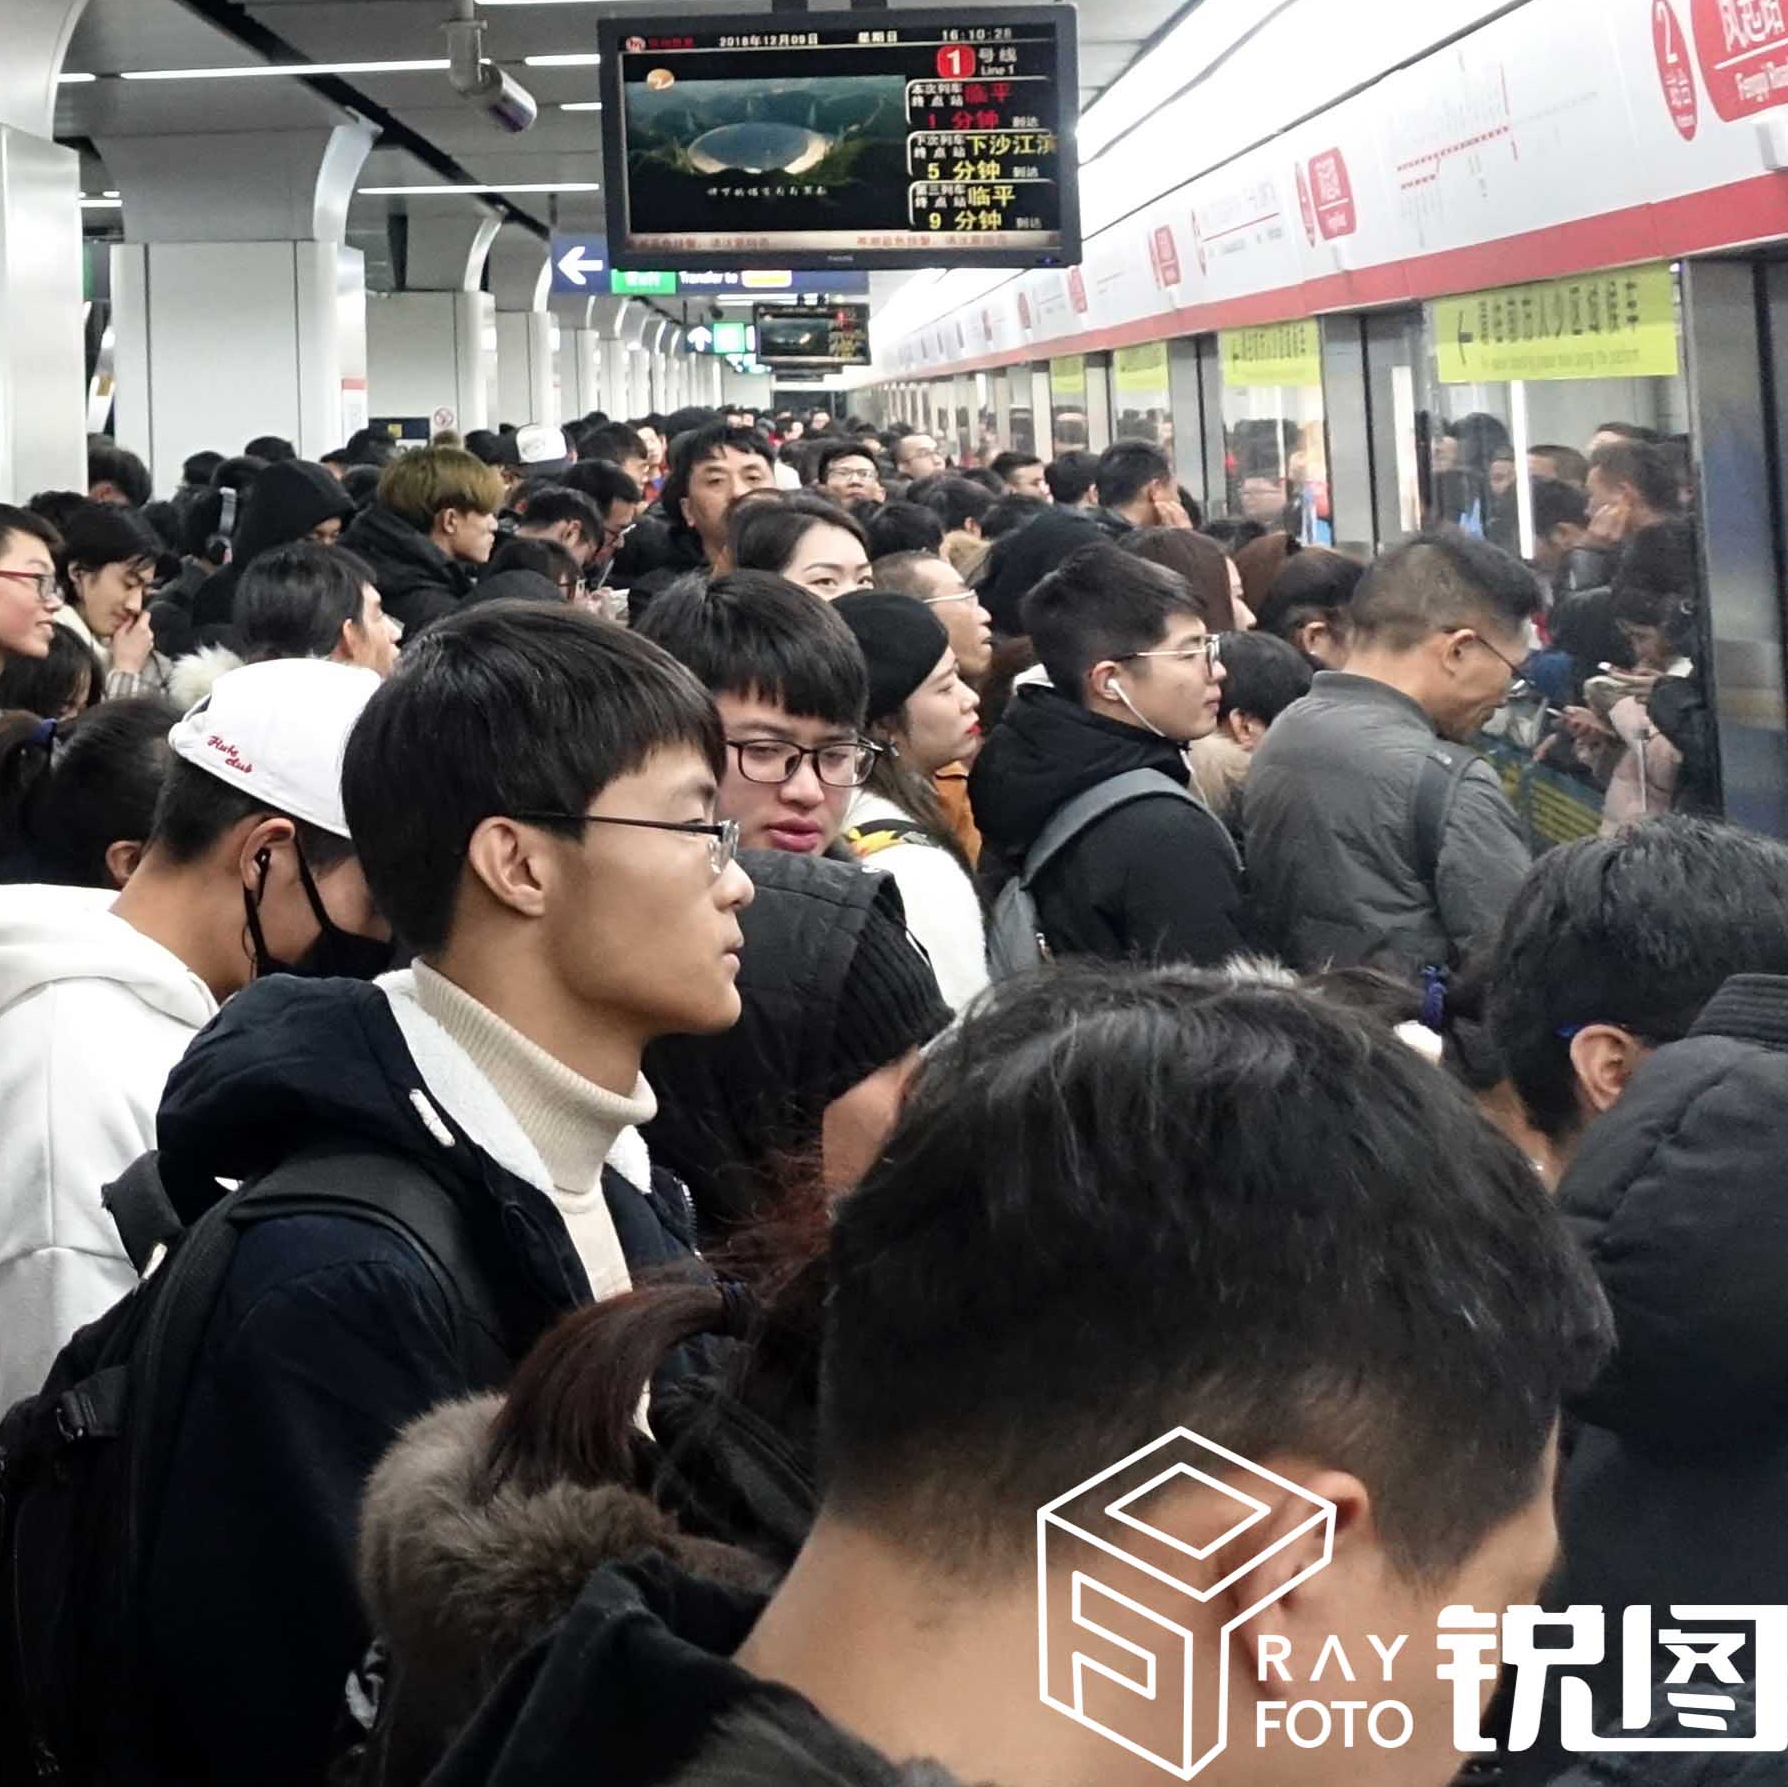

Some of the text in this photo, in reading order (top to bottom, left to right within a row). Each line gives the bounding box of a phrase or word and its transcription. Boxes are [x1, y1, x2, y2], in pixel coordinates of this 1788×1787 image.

[946, 49, 961, 75] 1
[978, 47, 1017, 63] 号线
[952, 110, 999, 129] 分钟
[927, 162, 940, 180] 5
[952, 160, 1001, 180] 分钟
[968, 185, 1016, 207] 临平
[928, 212, 941, 229] 9
[954, 209, 1002, 230] 分钟
